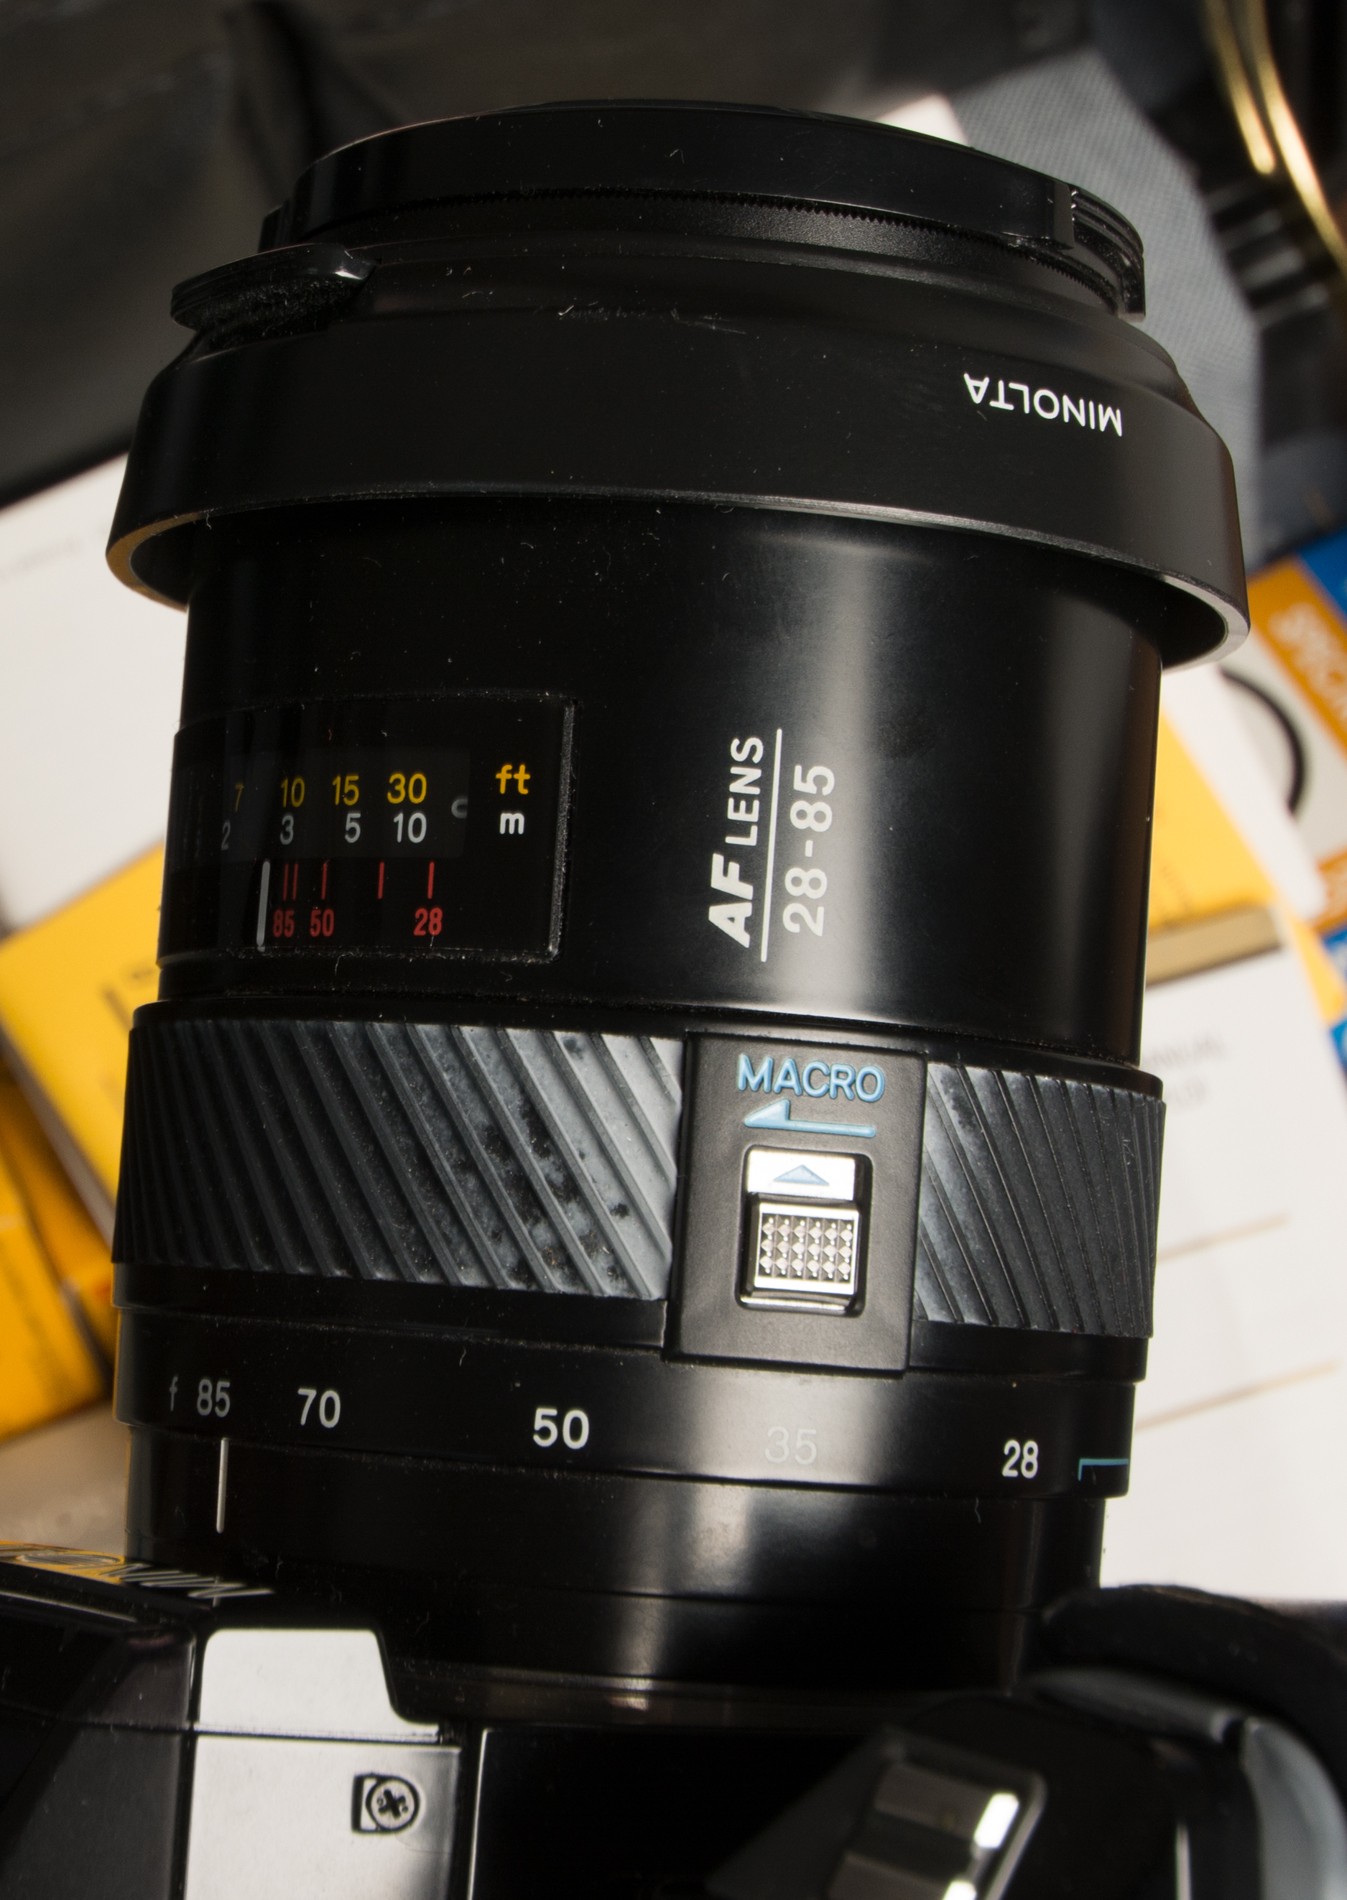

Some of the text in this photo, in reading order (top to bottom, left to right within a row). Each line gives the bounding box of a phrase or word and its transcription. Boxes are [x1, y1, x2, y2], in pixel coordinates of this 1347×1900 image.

[964, 372, 1123, 437] MINOLTA
[280, 776, 306, 807] 10
[331, 775, 360, 806] 15
[387, 773, 427, 804] 30
[496, 764, 531, 795] ft
[221, 812, 525, 850] 2 3 5 10 m
[708, 736, 764, 949] AF LENS
[782, 764, 835, 937] 28-85
[273, 907, 443, 938] 85 50 28
[737, 1053, 885, 1103] MACRO
[168, 1374, 1039, 1479] f 85 70 50 35 28
